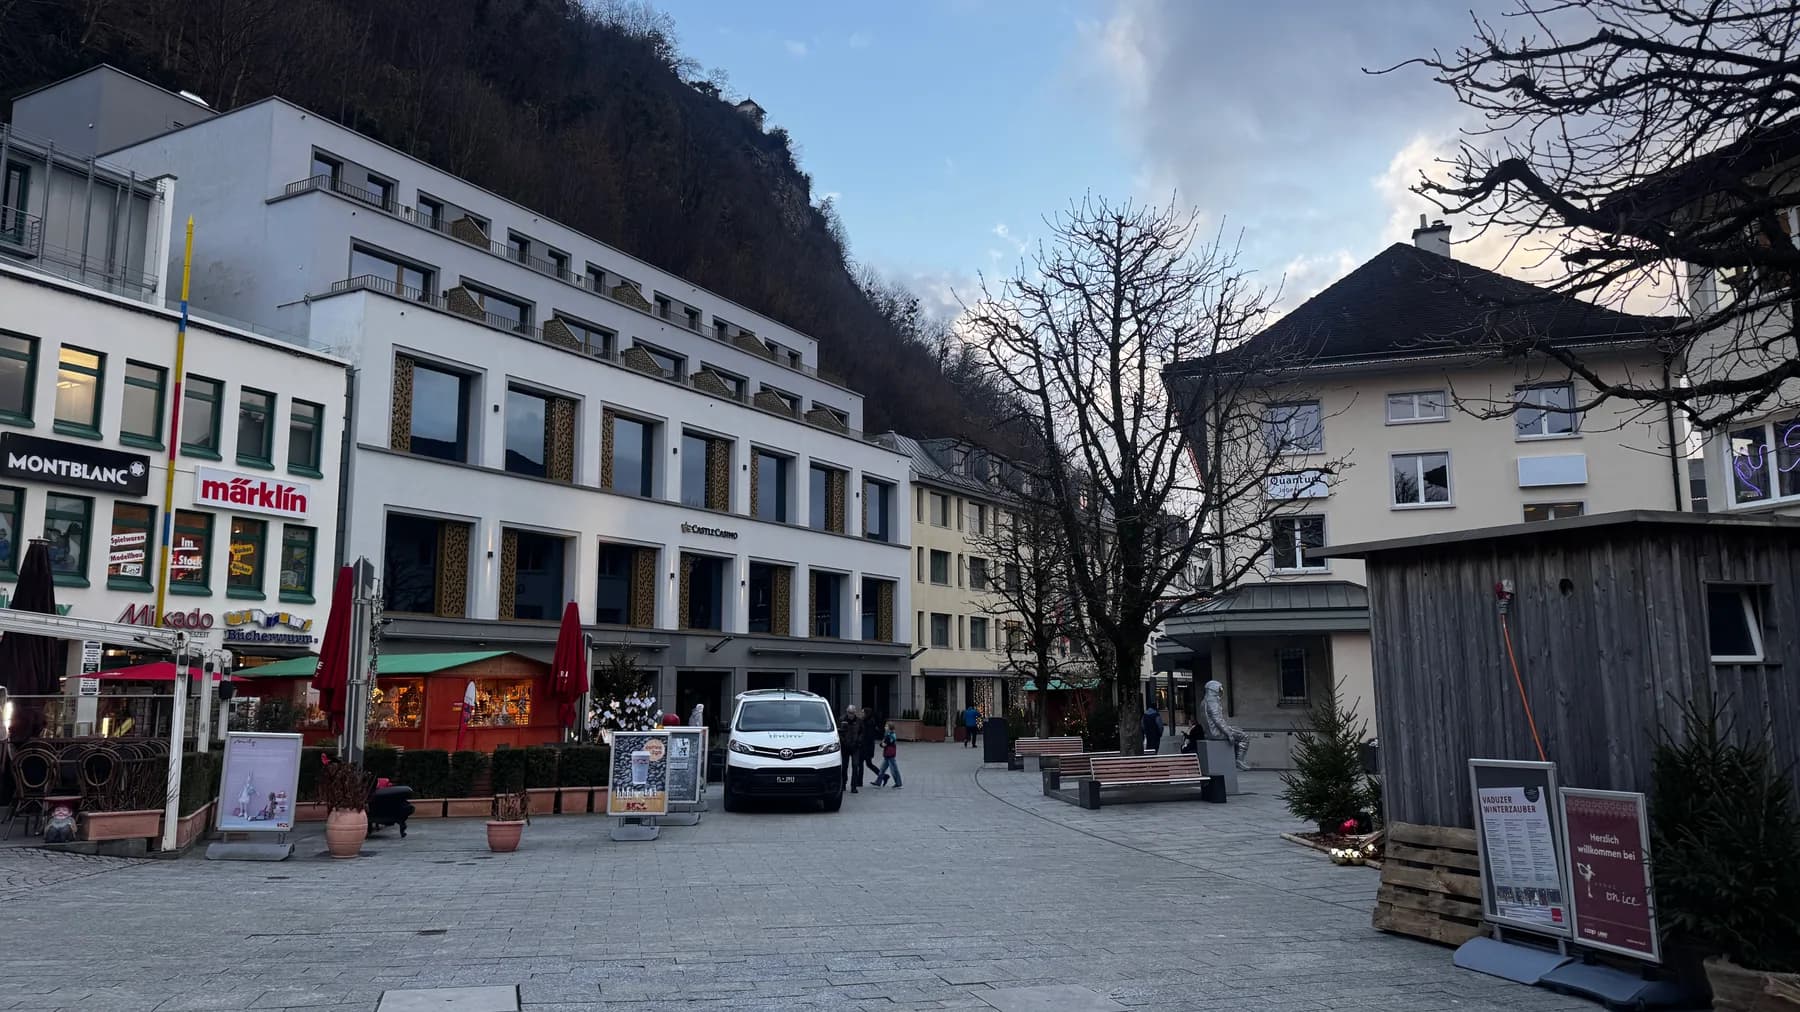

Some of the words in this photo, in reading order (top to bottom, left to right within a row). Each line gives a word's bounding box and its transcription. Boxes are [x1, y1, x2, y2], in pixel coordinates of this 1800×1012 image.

[8, 452, 128, 485] MONTBLANC
[202, 477, 307, 513] märklin
[111, 535, 145, 544] Spielwaren
[181, 537, 194, 548] Im
[110, 552, 143, 561] Modellbau
[178, 554, 203, 568] Stock
[118, 603, 214, 629] Mikado
[1482, 796, 1512, 804] VADUZER
[1484, 805, 1536, 813] WINTERZAUBER
[1590, 833, 1619, 844] Herzlich
[1577, 844, 1621, 858] willkommen
[1623, 850, 1636, 861] bei
[1622, 891, 1641, 906] ice
